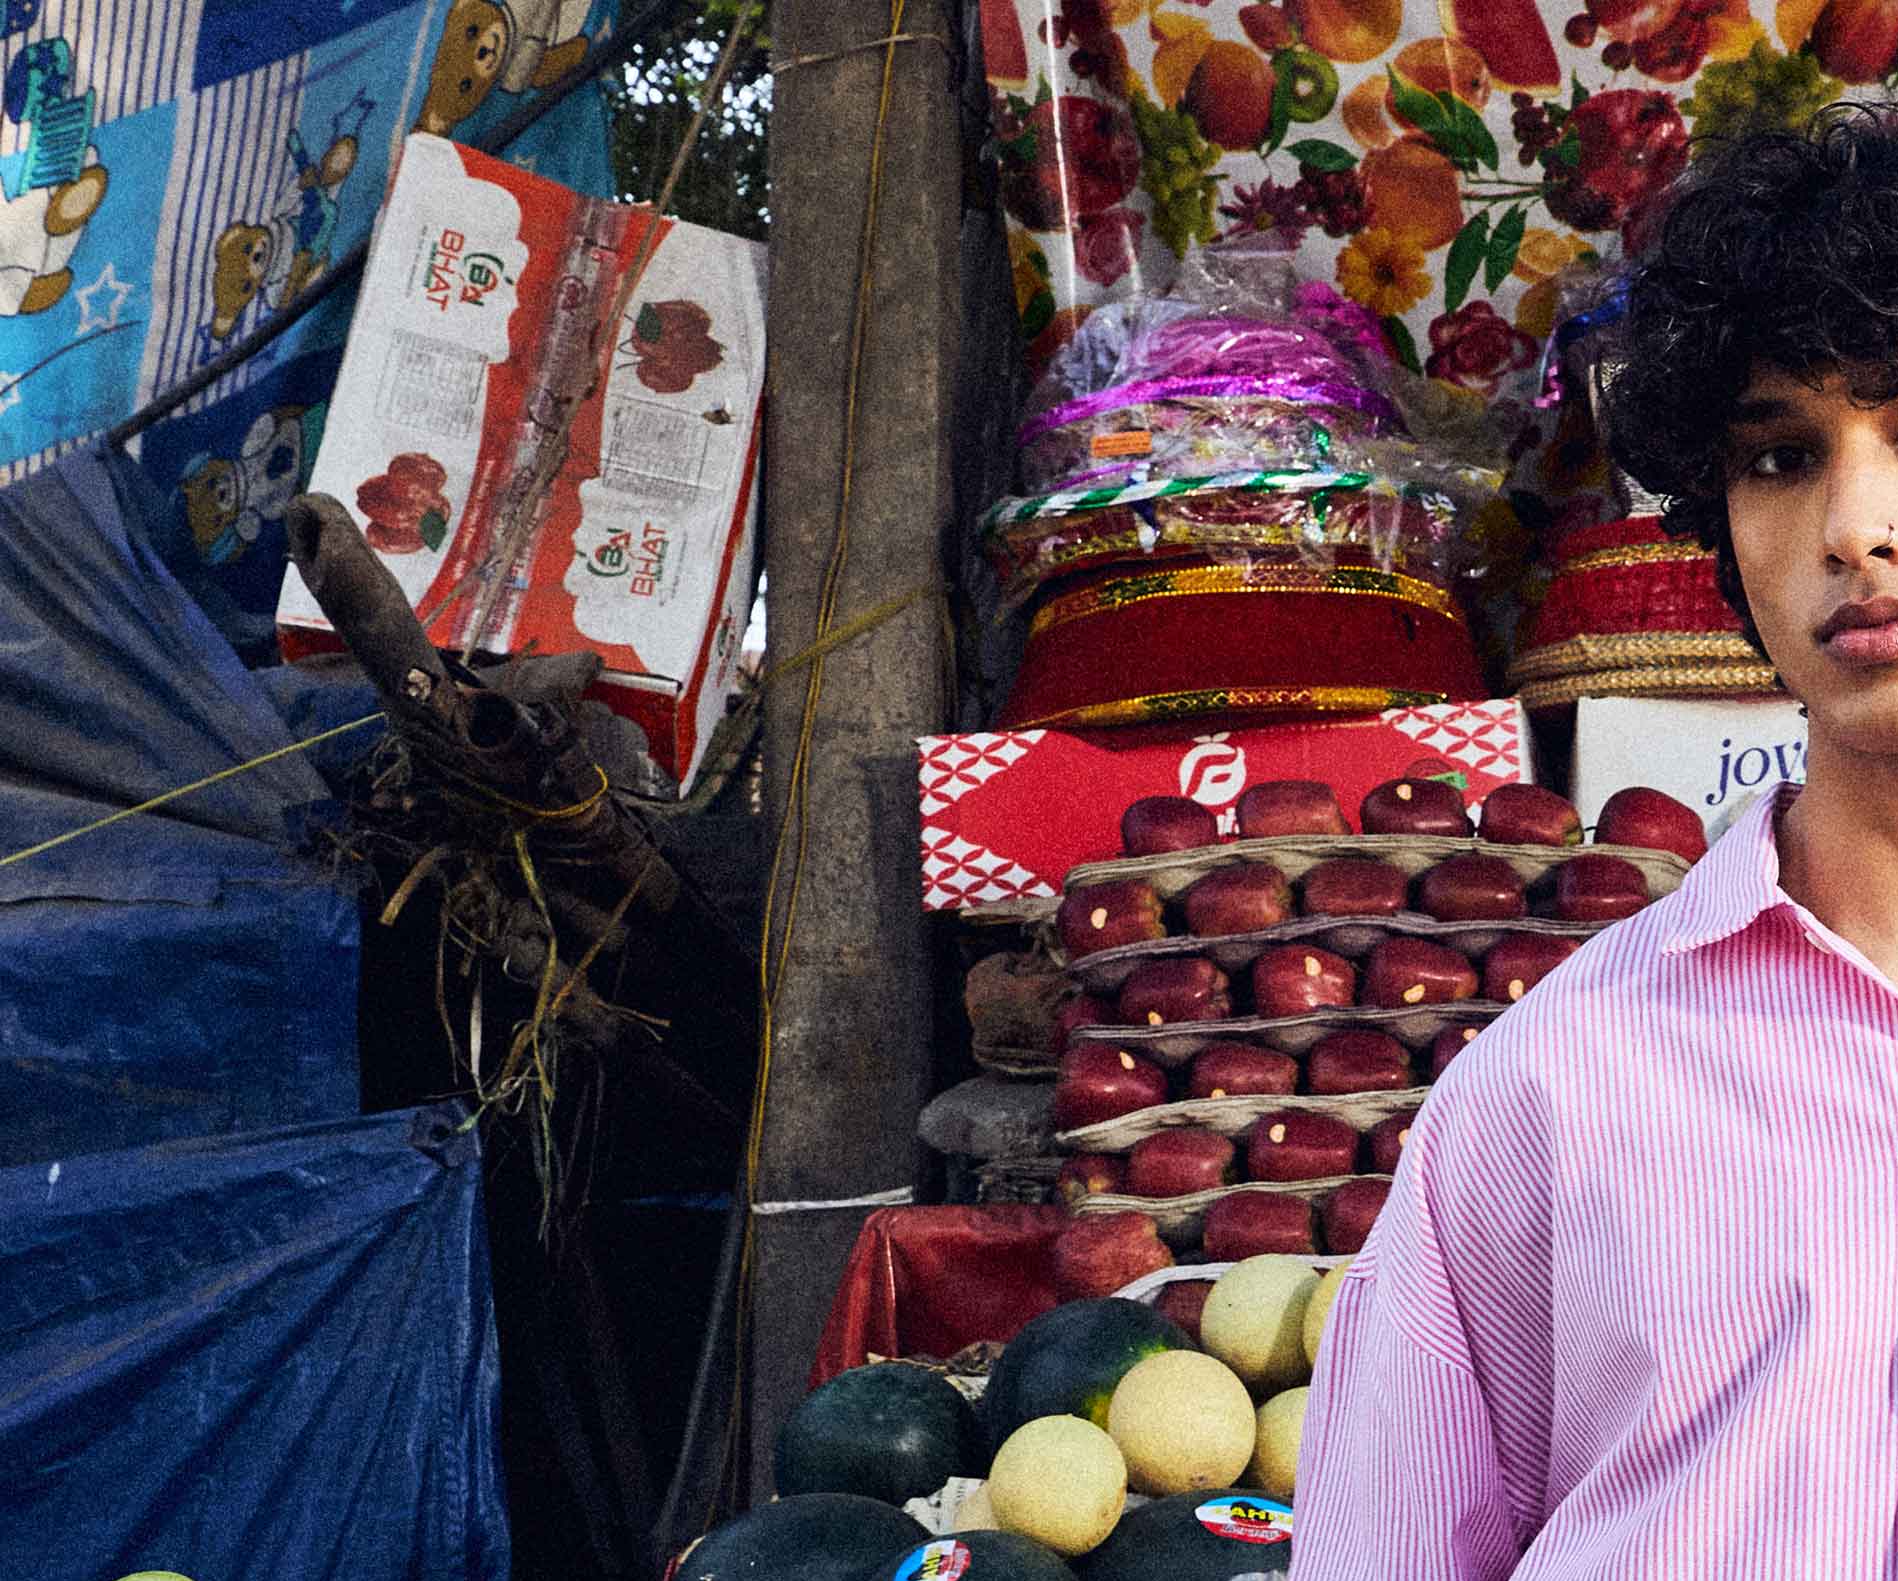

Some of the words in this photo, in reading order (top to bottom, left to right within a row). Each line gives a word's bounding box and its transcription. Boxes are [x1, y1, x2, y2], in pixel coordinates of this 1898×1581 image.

[426, 228, 464, 312] BHAT
[631, 522, 666, 597] BHAT
[1705, 737, 1808, 805] jov
